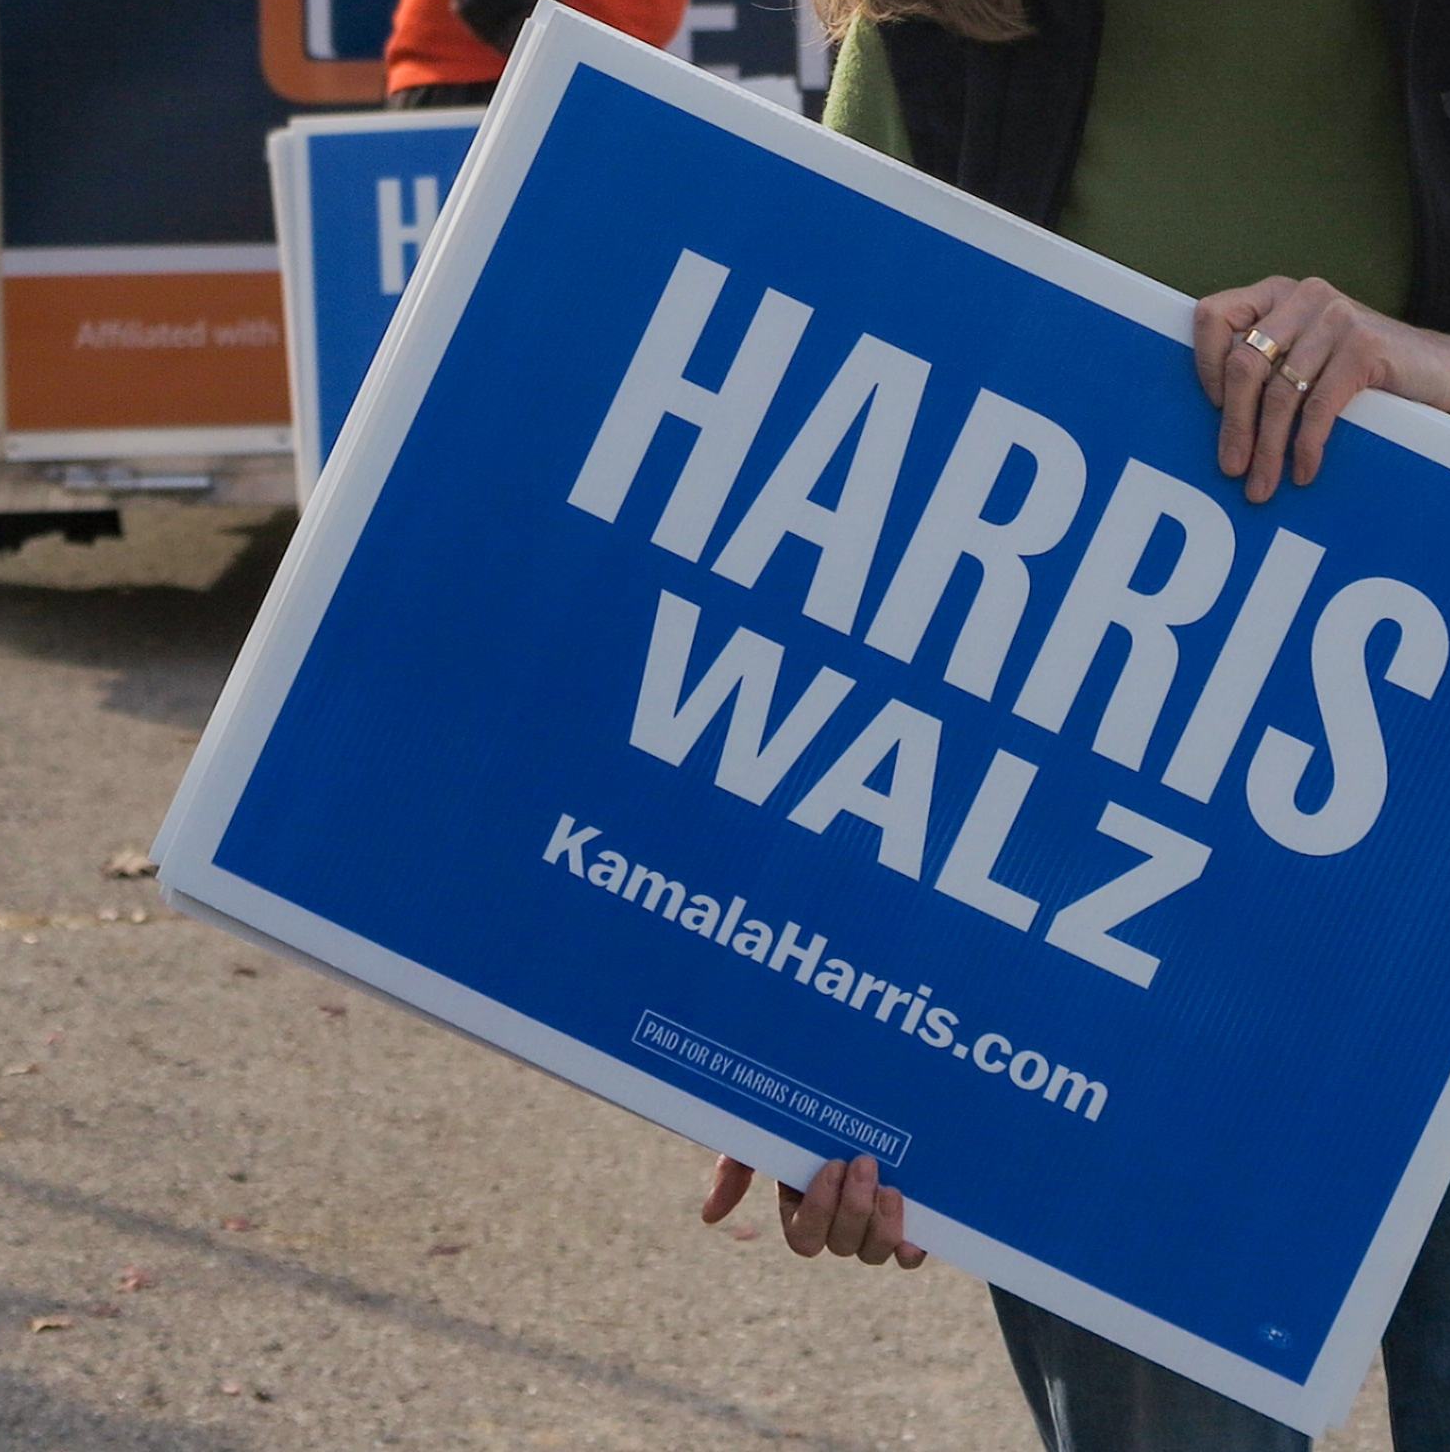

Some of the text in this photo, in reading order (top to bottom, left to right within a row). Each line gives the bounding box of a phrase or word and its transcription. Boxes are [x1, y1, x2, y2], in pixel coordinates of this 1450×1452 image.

[566, 247, 1450, 856] HARRIS
[628, 588, 1213, 989] WALZ
[542, 813, 1109, 1122] KamalaHarris.com
[643, 1020, 901, 1156] PAID FOR BY HARRIS FOR PRESIDENT
